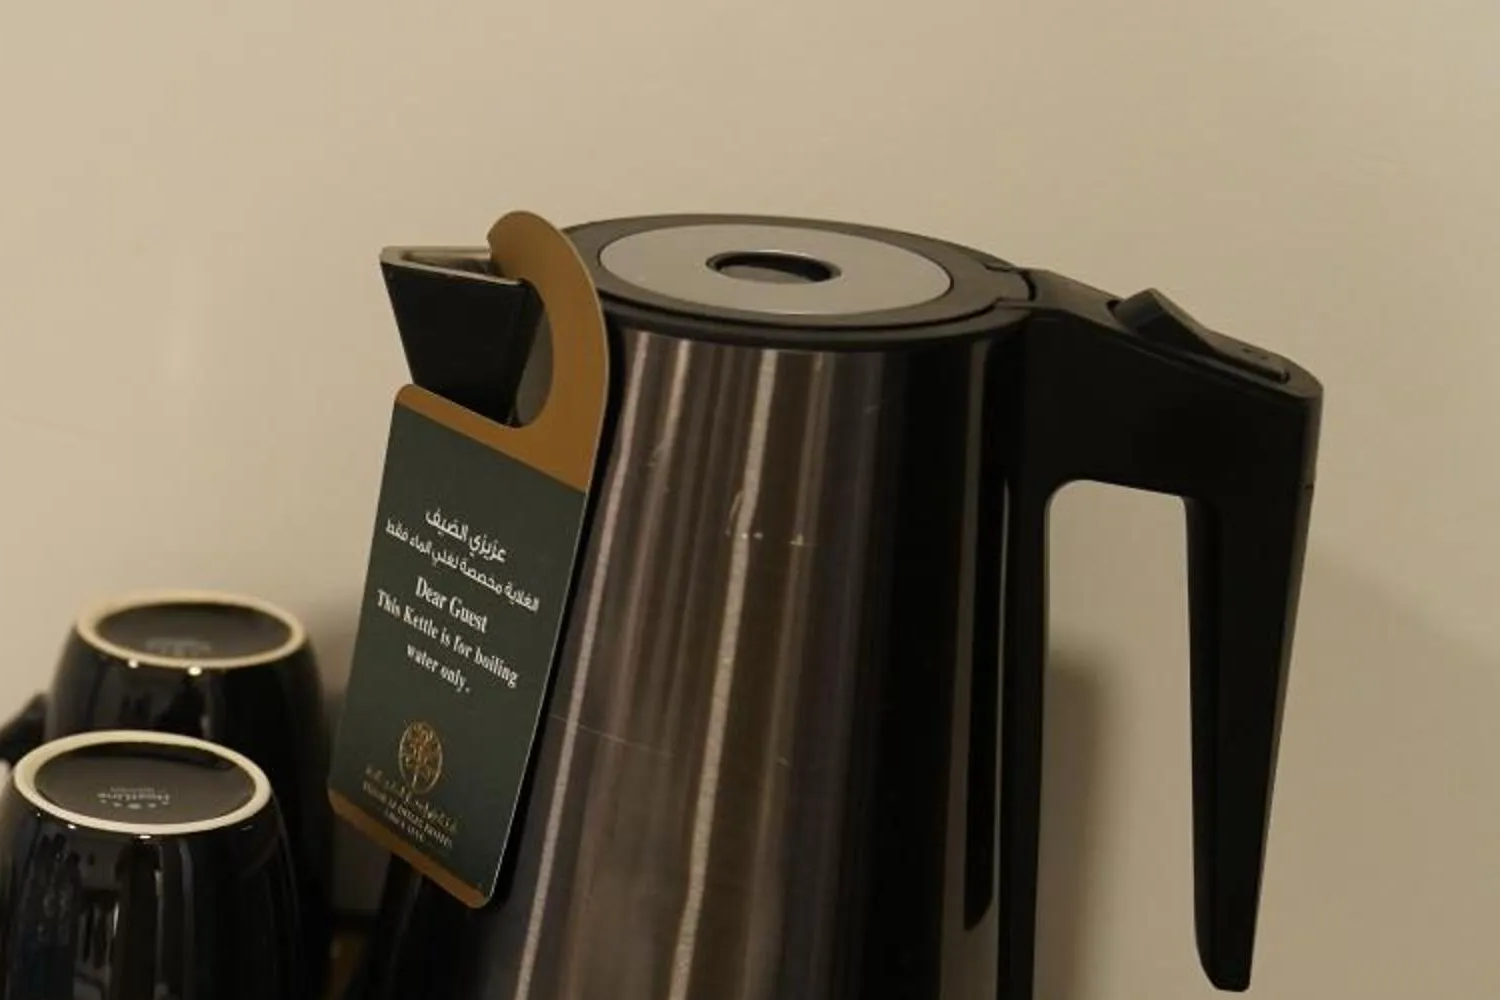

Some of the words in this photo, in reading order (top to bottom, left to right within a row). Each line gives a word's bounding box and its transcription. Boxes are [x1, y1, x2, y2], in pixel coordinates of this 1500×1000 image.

[385, 518, 409, 542] فقط
[425, 507, 469, 541] الضيف
[469, 534, 507, 563] عزيزي
[415, 576, 448, 609] Dear
[449, 595, 488, 634] Guest
[377, 588, 401, 618] This
[403, 604, 439, 640] Kettle
[440, 626, 451, 647] is
[453, 634, 473, 659] for
[474, 646, 518, 689] boiling
[407, 643, 440, 673] water
[440, 665, 471, 693] only.
